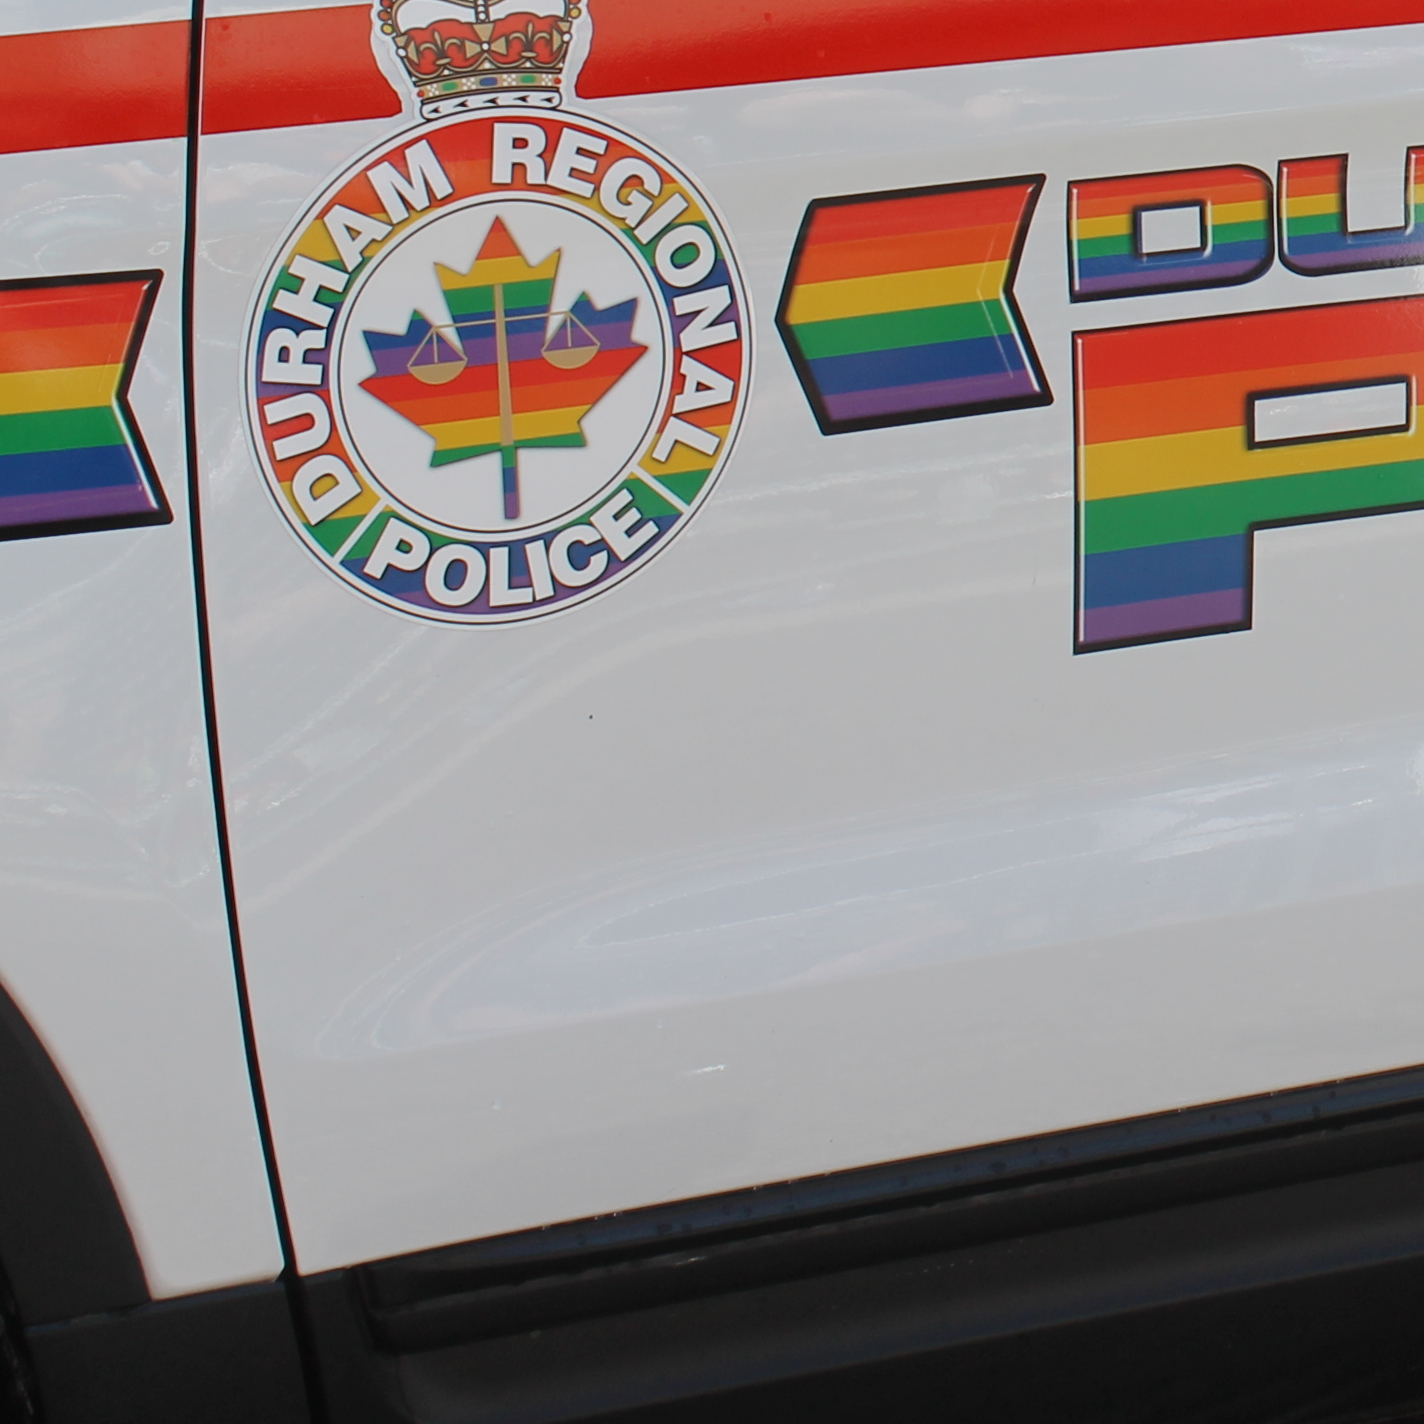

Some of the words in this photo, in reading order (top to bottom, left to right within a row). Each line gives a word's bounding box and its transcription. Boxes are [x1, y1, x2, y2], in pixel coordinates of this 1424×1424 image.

[260, 137, 456, 527] DURHAM
[490, 120, 740, 466] REGIONAL
[362, 487, 661, 609] POLICE
